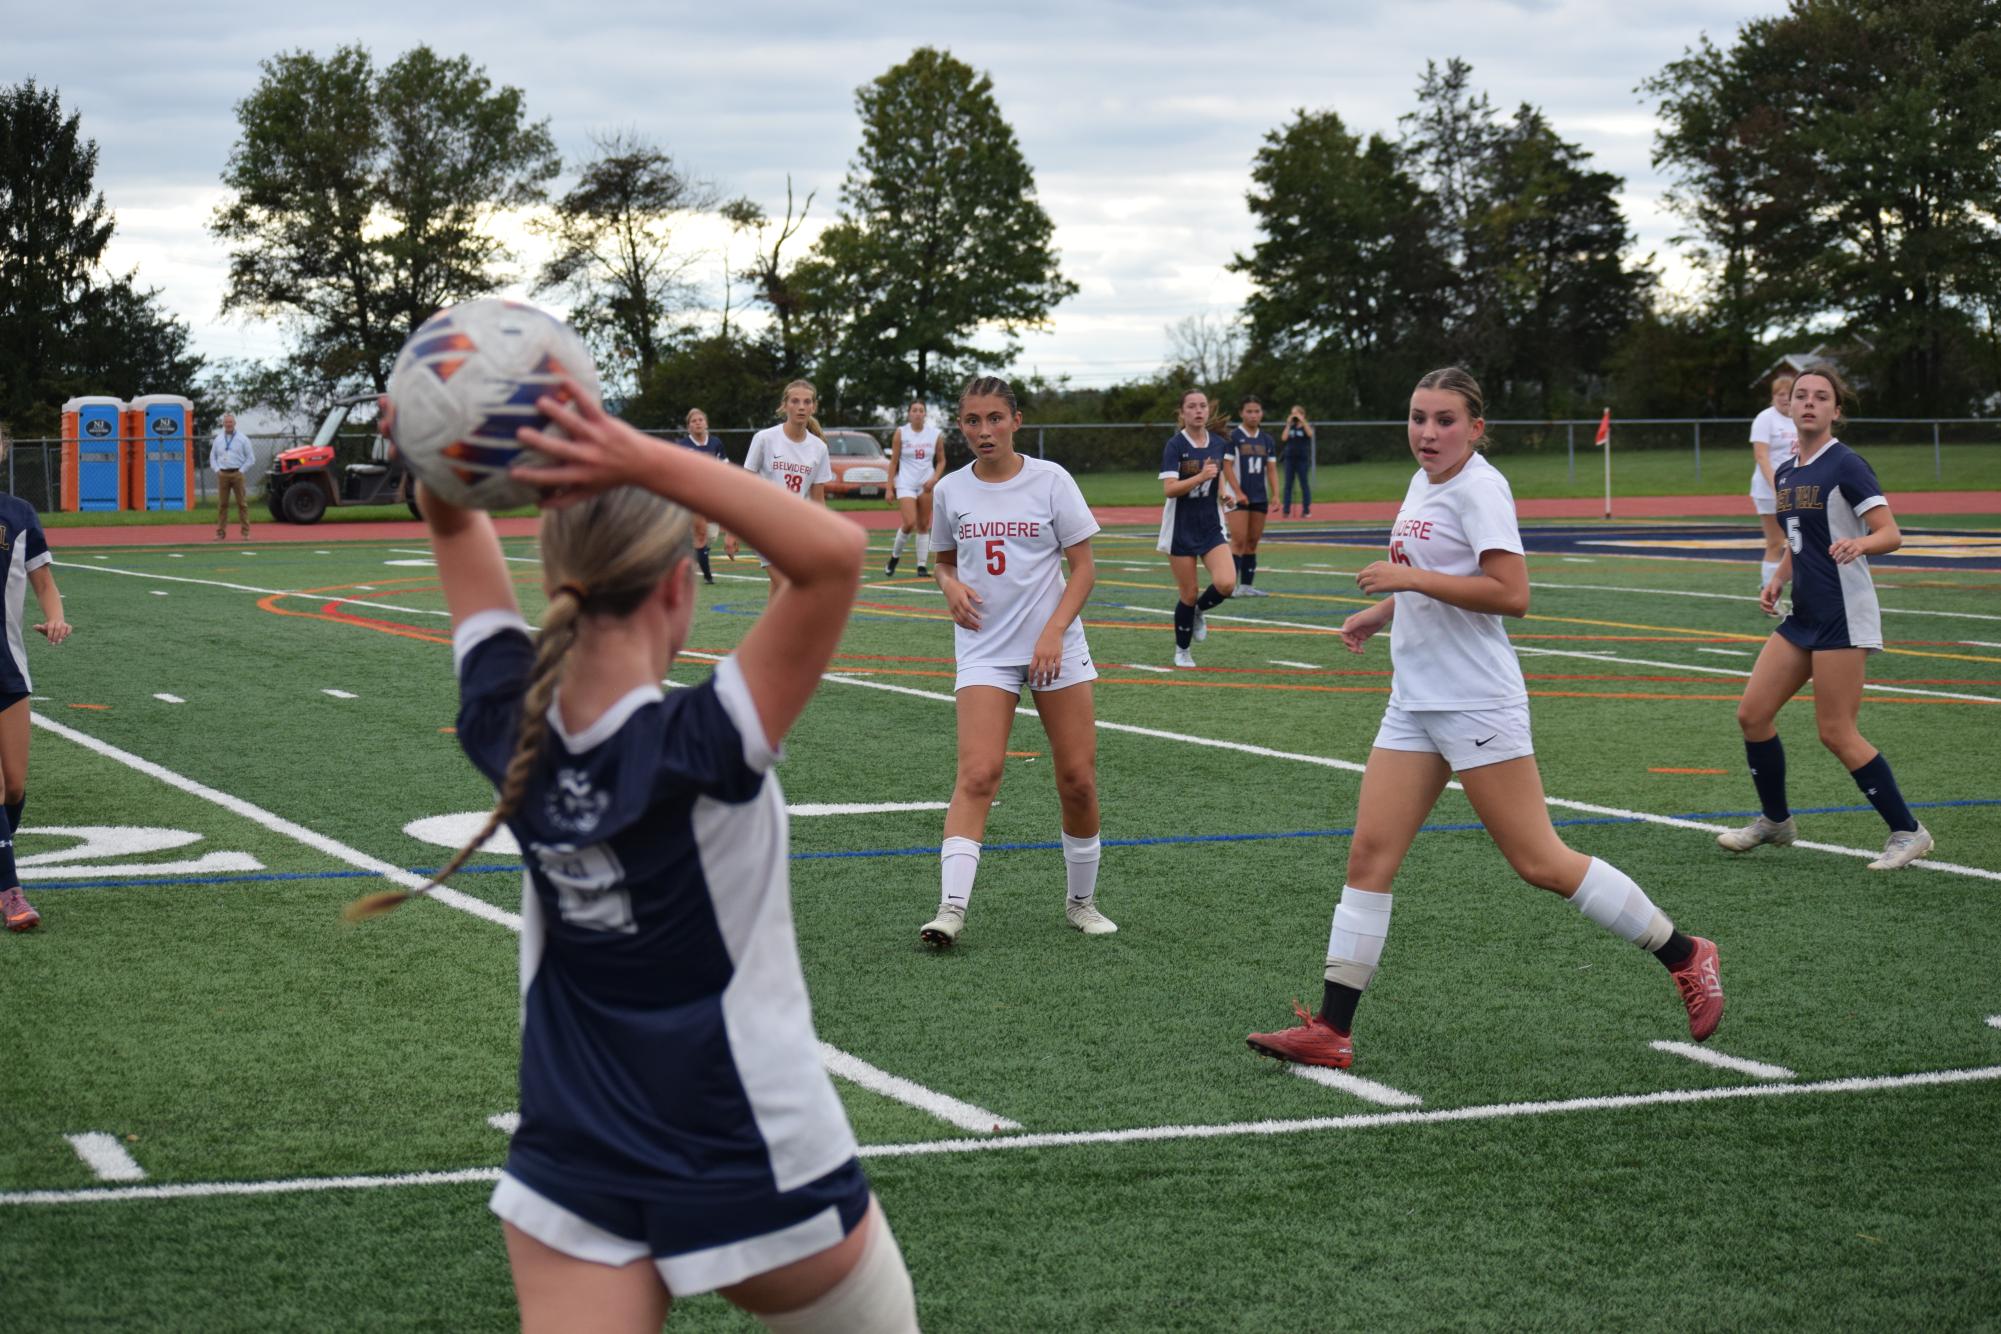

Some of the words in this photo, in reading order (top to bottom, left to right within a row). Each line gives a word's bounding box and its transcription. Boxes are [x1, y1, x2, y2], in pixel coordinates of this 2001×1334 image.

[1248, 457, 1262, 474] 14
[959, 522, 1040, 540] BELVIDERE
[1786, 516, 1803, 555] 5
[985, 540, 1006, 576] 5
